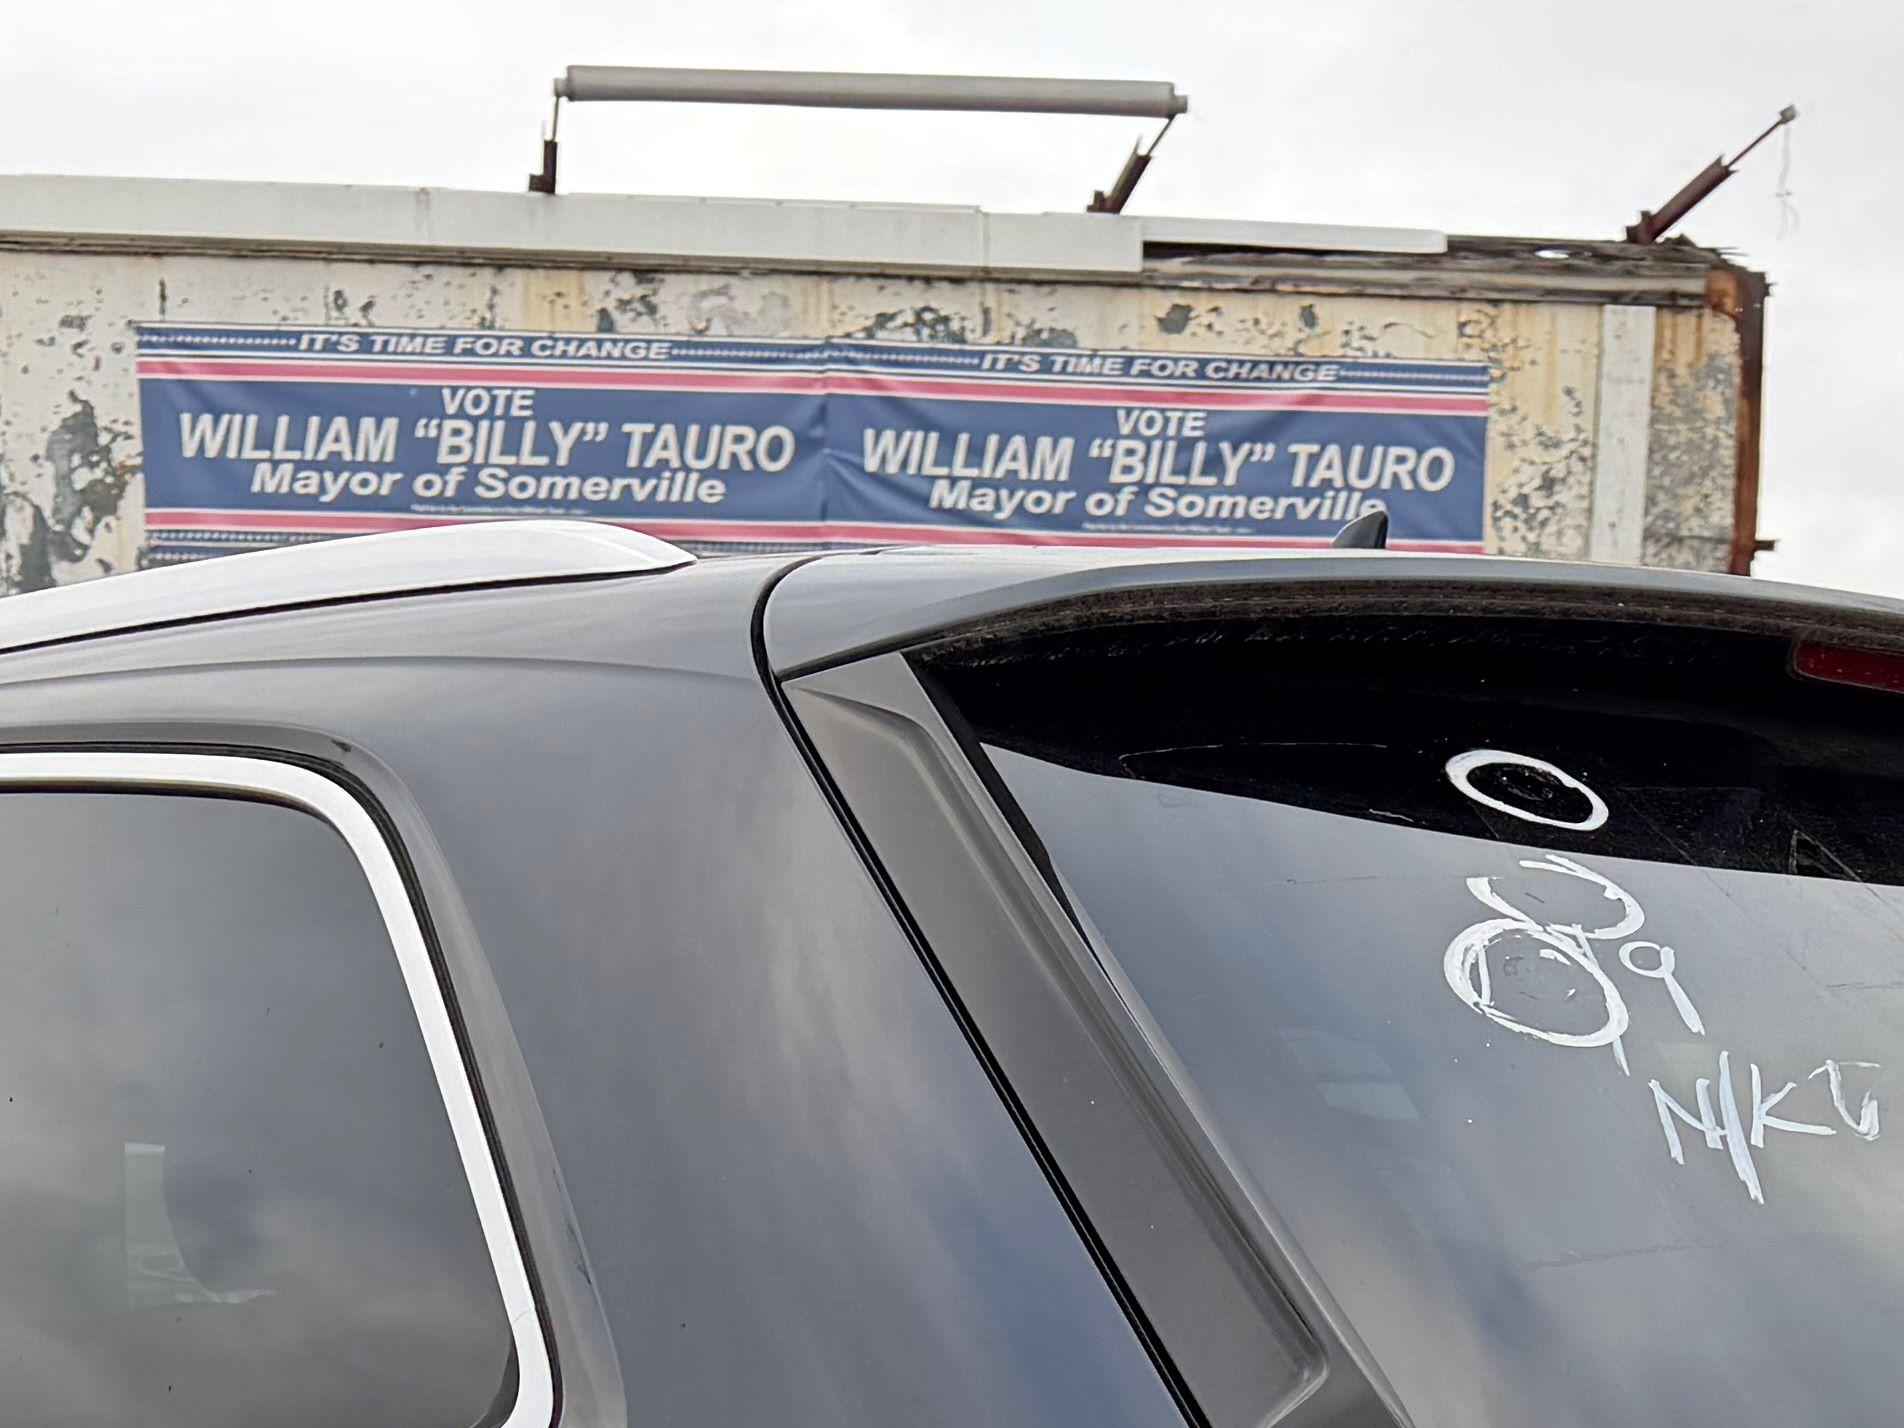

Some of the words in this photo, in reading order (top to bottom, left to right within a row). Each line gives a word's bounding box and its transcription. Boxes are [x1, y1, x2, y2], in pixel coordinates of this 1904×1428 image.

[298, 334, 360, 352] IT'S
[370, 335, 448, 355] TIME
[454, 337, 523, 356] FOR
[530, 338, 672, 360] CHANGE
[981, 353, 1041, 372] IT'S
[1051, 355, 1123, 375] TIME
[1130, 358, 1199, 377] FOR
[1205, 361, 1340, 382] CHANGE
[441, 388, 536, 417] VOTE
[1116, 409, 1208, 437] VOTE
[180, 412, 400, 463] WILLIAM
[621, 423, 795, 472] TAURO
[863, 428, 1075, 482] WILLIAM
[1288, 444, 1456, 492] TAURO
[250, 462, 403, 502] Mayor
[412, 466, 468, 498] of
[474, 467, 727, 503] Somerville
[929, 479, 1077, 520] Mayor
[1084, 486, 1138, 517] of
